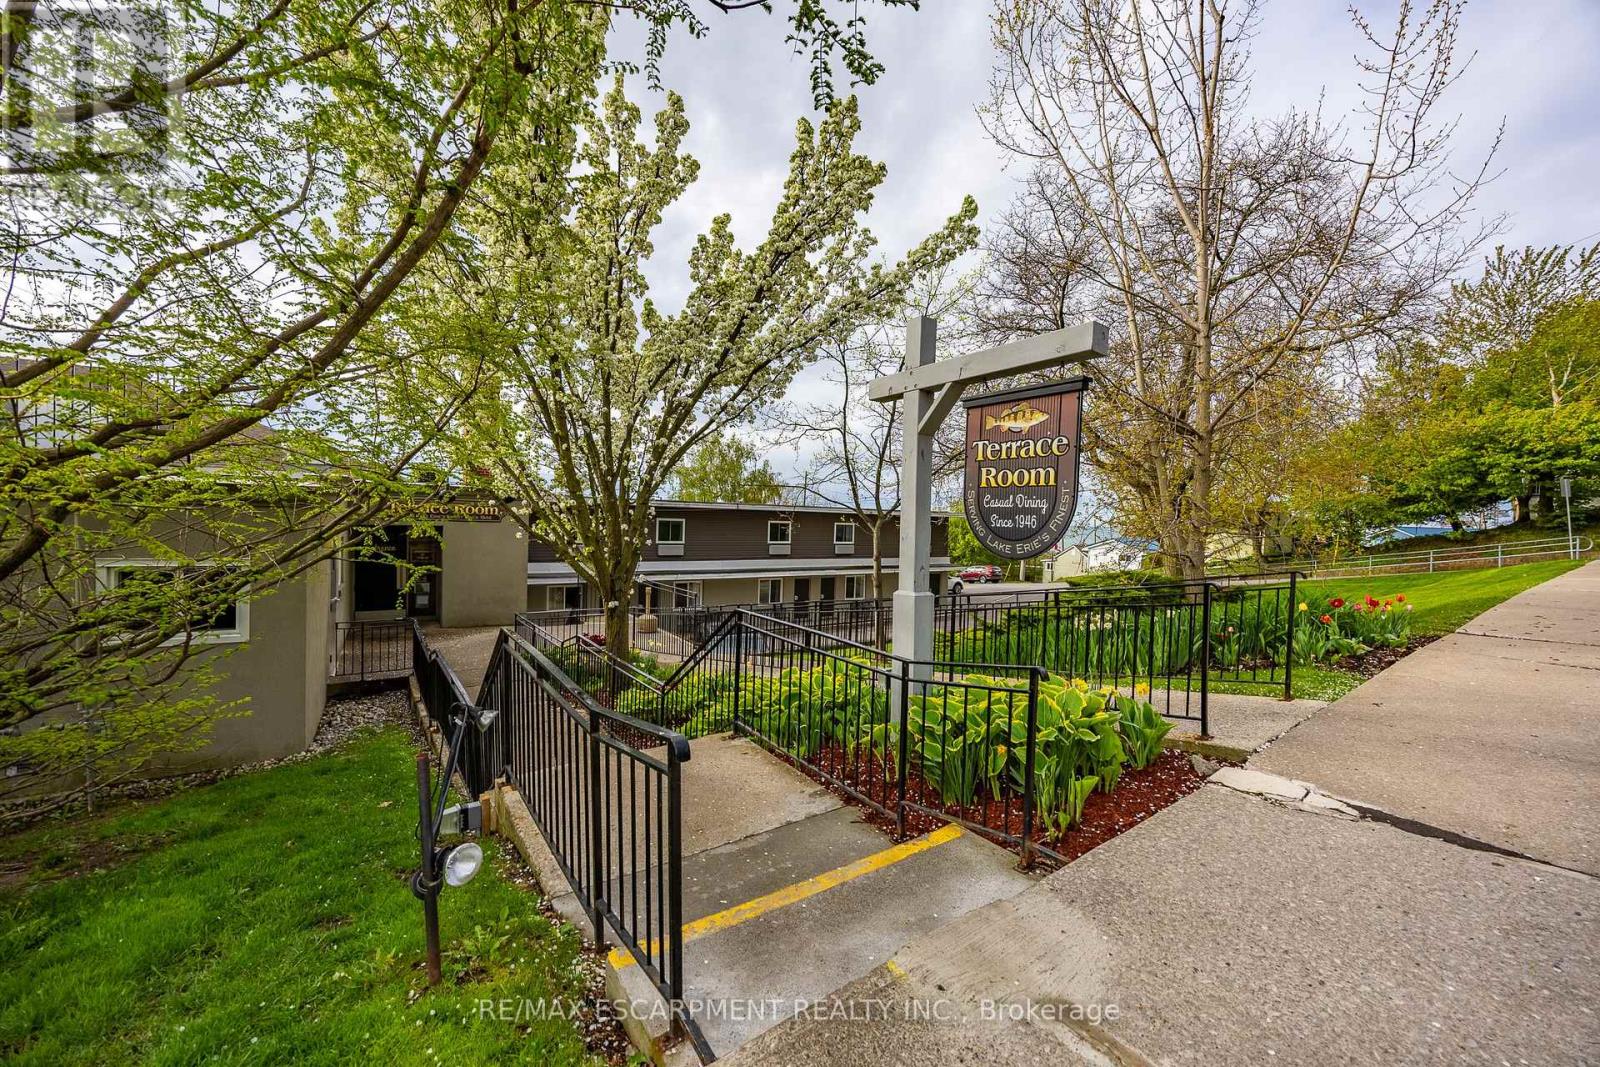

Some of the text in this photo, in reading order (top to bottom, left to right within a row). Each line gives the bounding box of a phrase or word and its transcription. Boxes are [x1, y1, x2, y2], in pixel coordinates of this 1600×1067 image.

[972, 435, 1070, 461] Terrace
[979, 466, 1057, 488] Room
[389, 502, 449, 515] Tece
[983, 493, 1049, 514] Casual Dining
[967, 488, 1071, 554] SERVING LAKE ERIE'S FINEST
[990, 514, 1037, 528] Since 1946
